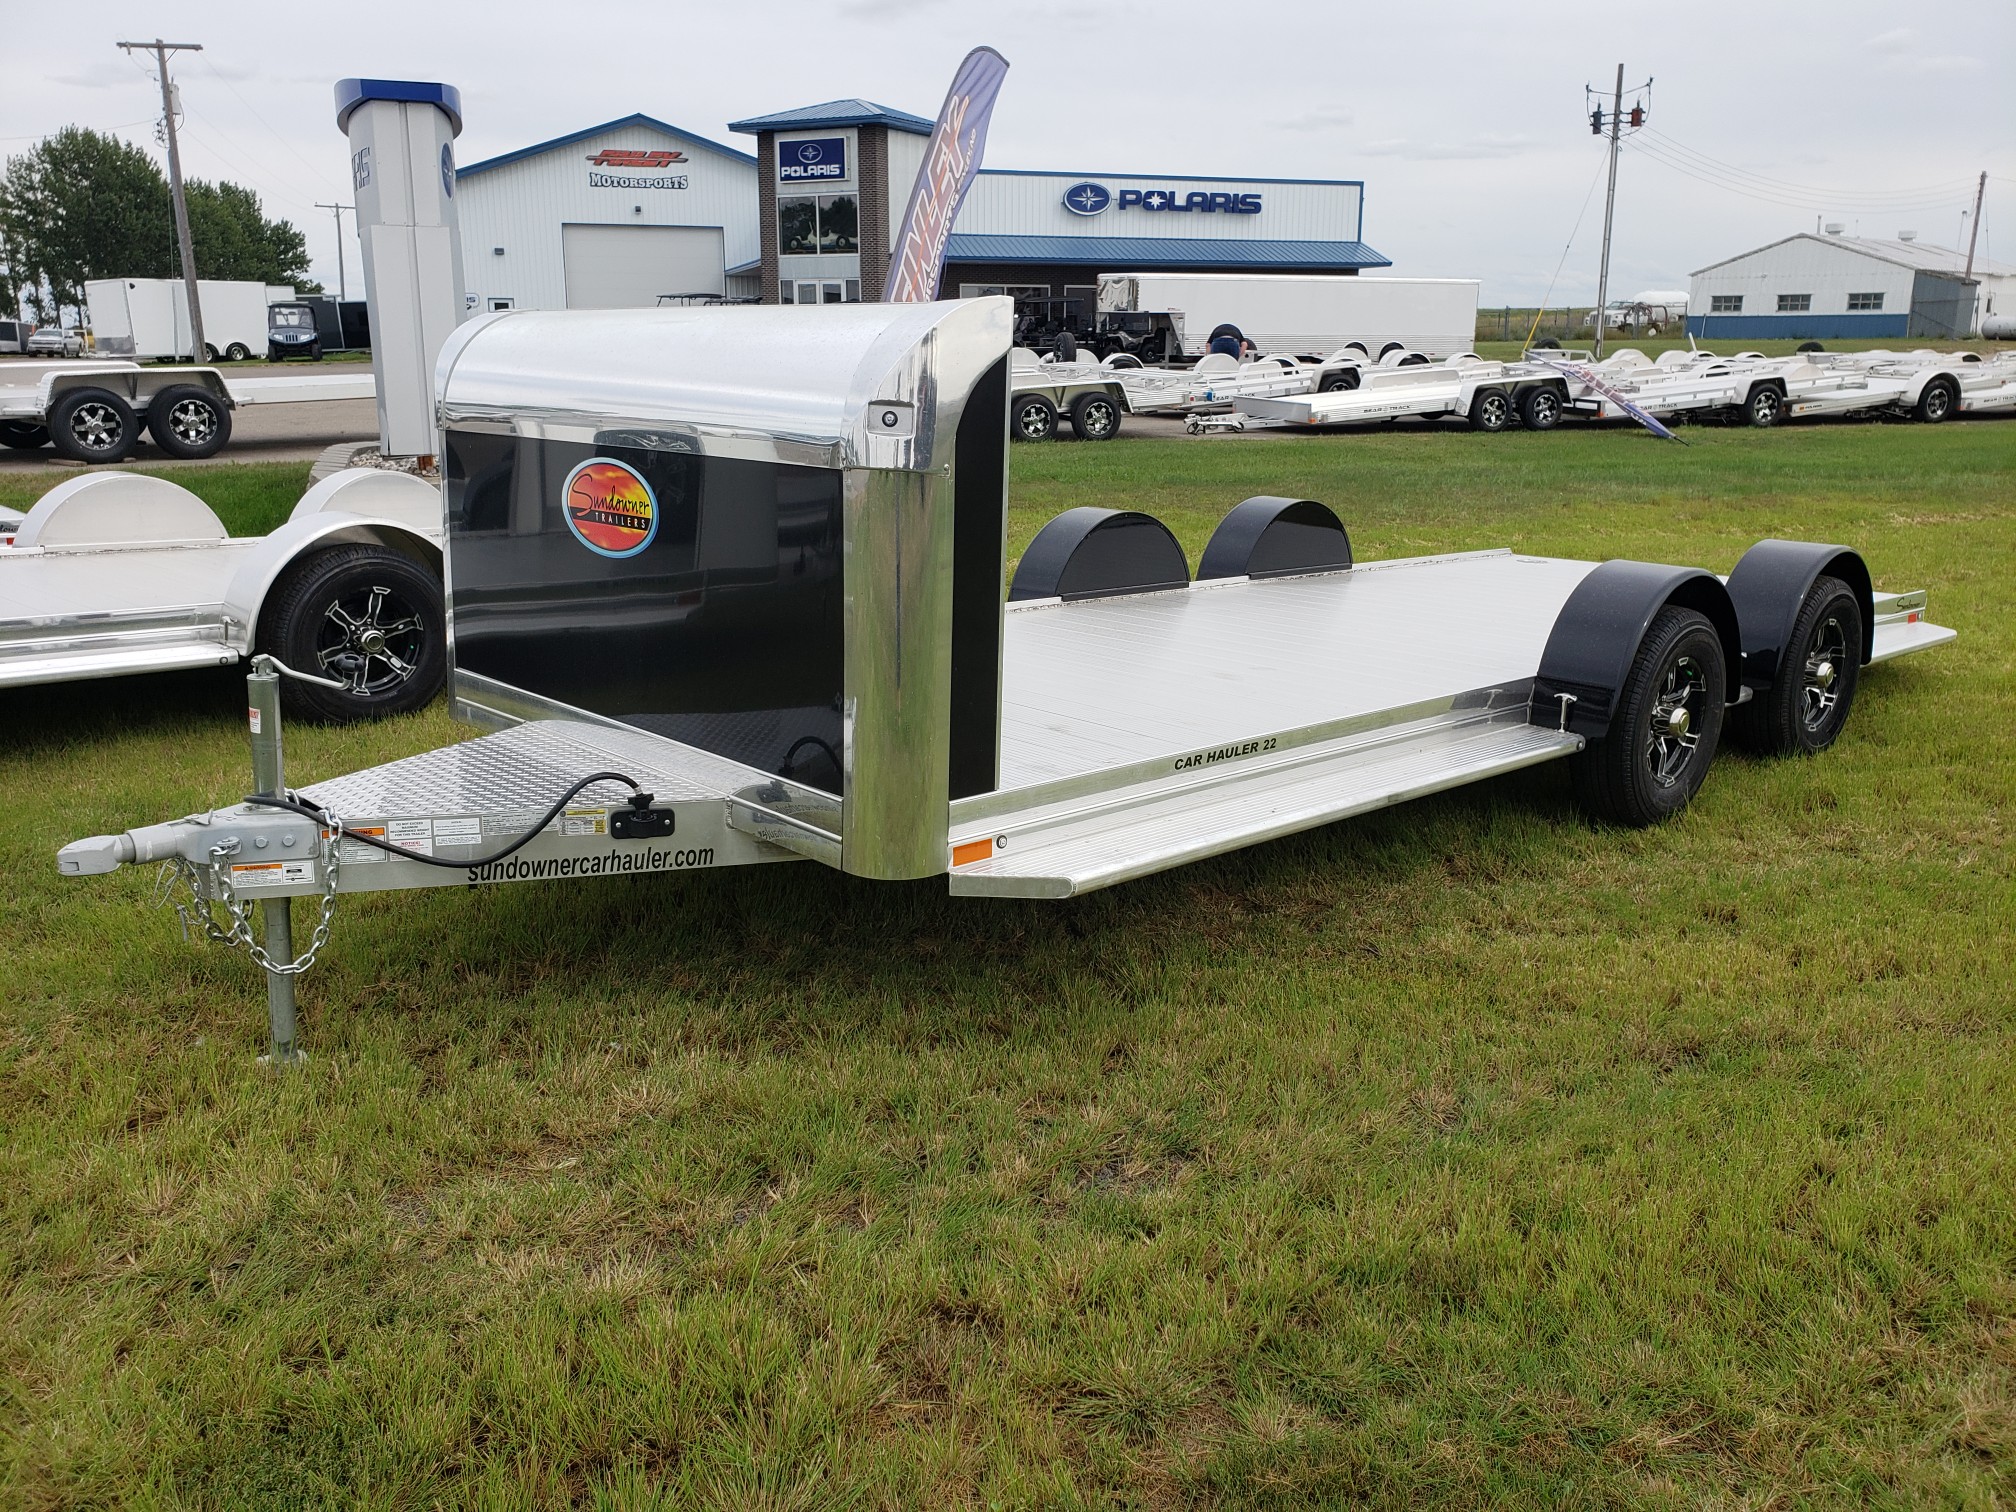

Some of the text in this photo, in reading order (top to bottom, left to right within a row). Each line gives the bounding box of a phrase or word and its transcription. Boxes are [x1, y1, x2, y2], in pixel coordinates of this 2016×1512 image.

[589, 172, 689, 190] MOTORSPORTS
[781, 164, 841, 178] POLARIS
[1118, 189, 1262, 215] POLARIS
[572, 473, 650, 517] Sundowner
[595, 512, 646, 529] TRAILERS
[1174, 738, 1277, 770] CAR HAULER 22
[467, 847, 715, 883] sundownercarhauler.com
